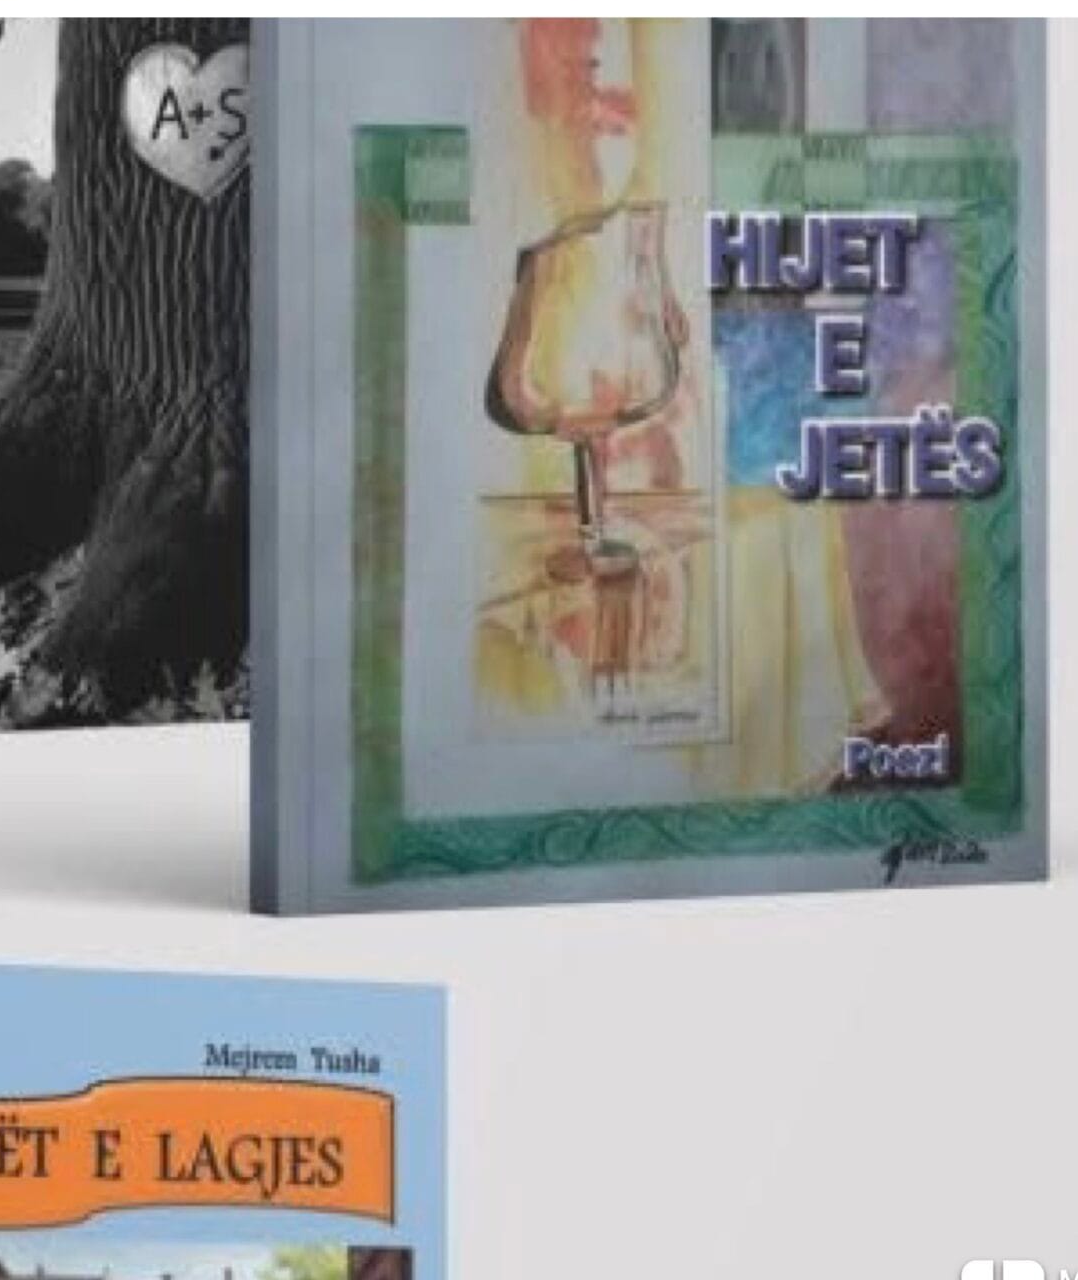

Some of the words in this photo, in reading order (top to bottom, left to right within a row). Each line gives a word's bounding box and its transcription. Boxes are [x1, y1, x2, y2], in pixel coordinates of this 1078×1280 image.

[705, 211, 919, 293] HIJET
[815, 315, 868, 396] E
[775, 403, 1002, 501] JETËS
[844, 733, 949, 778] Poezi
[310, 1046, 380, 1073] Tusha
[93, 1131, 122, 1181] E
[157, 1131, 345, 1201] LAGJES
